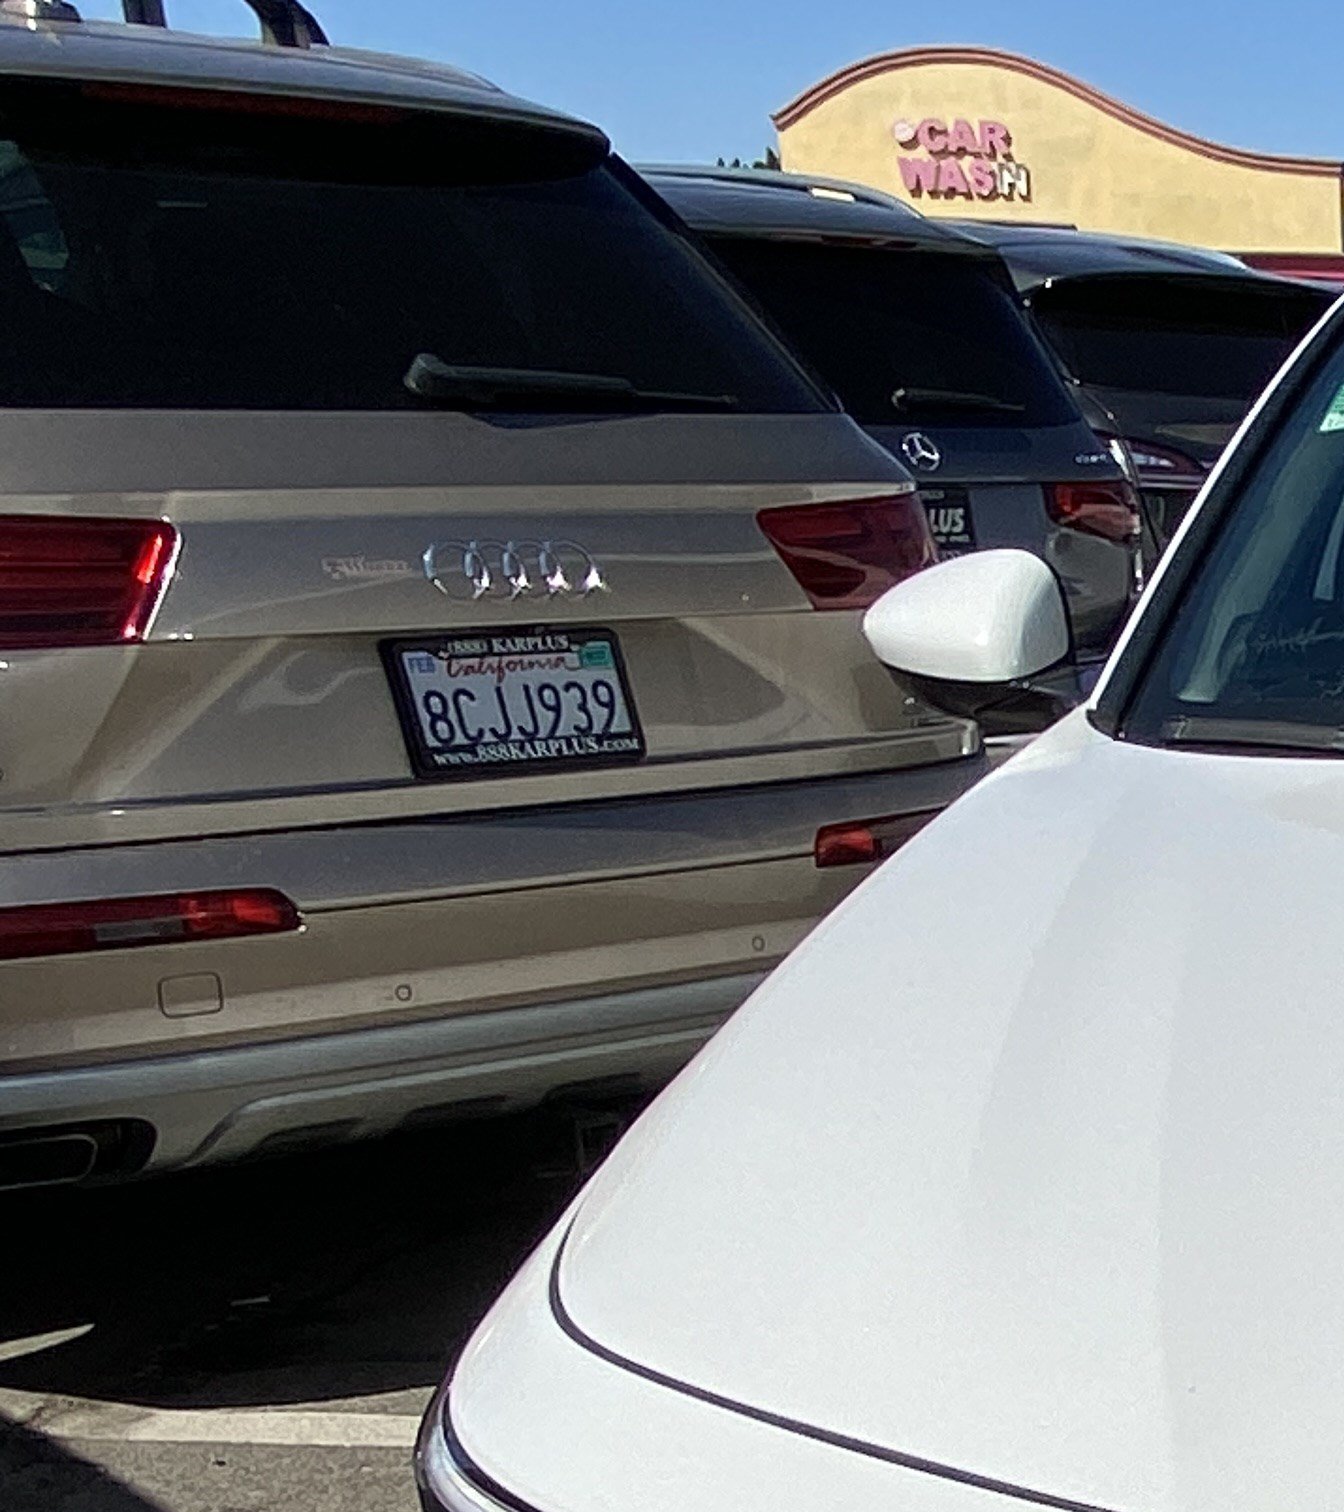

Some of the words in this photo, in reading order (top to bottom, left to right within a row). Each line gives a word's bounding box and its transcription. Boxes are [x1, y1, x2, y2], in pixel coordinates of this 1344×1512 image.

[916, 117, 1012, 160] CAR
[897, 155, 1032, 202] WASH
[491, 634, 570, 652] KARPLUS
[446, 655, 584, 683] California
[422, 679, 616, 745] 8CJJ939
